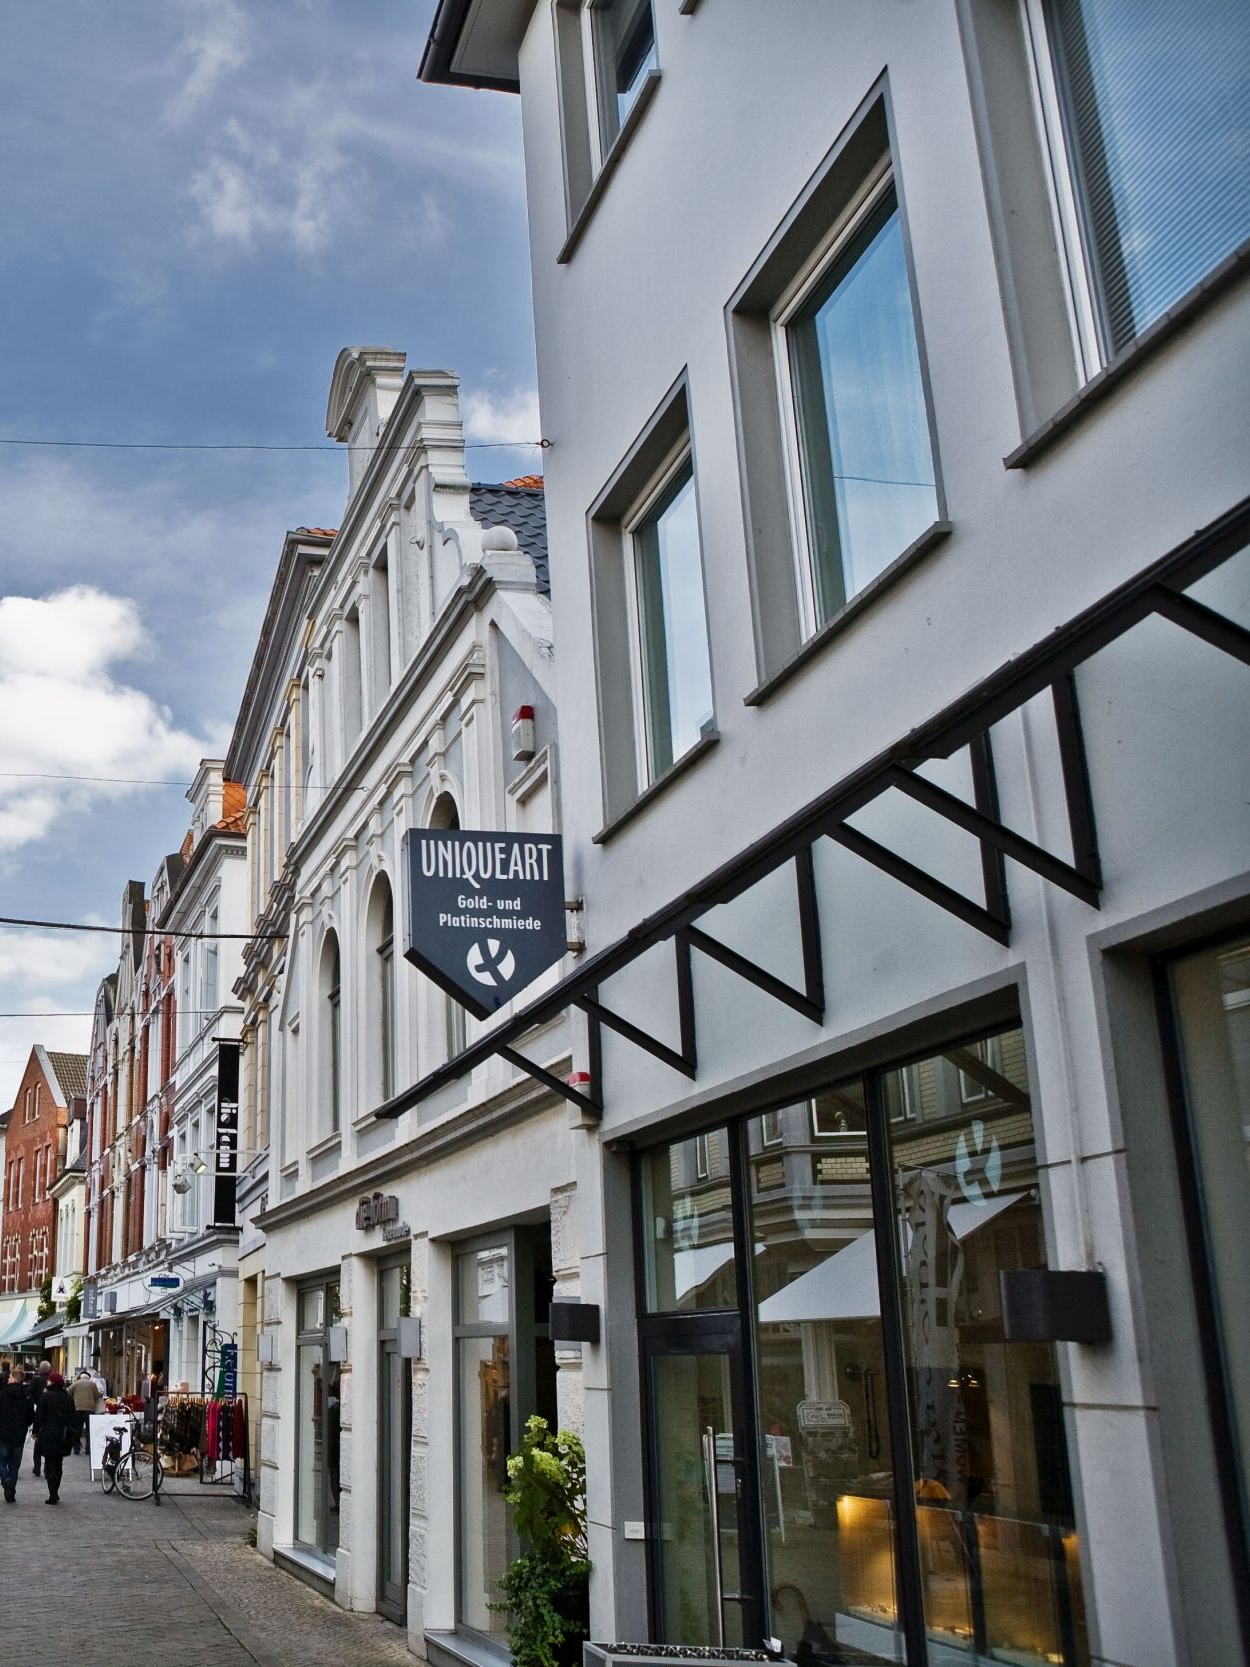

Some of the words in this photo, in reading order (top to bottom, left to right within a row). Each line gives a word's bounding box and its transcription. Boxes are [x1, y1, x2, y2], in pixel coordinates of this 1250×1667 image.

[420, 839, 552, 889] UNIQUEART
[457, 895, 493, 910] Gold-
[497, 897, 521, 911] und
[439, 913, 542, 931] Platinschmiede
